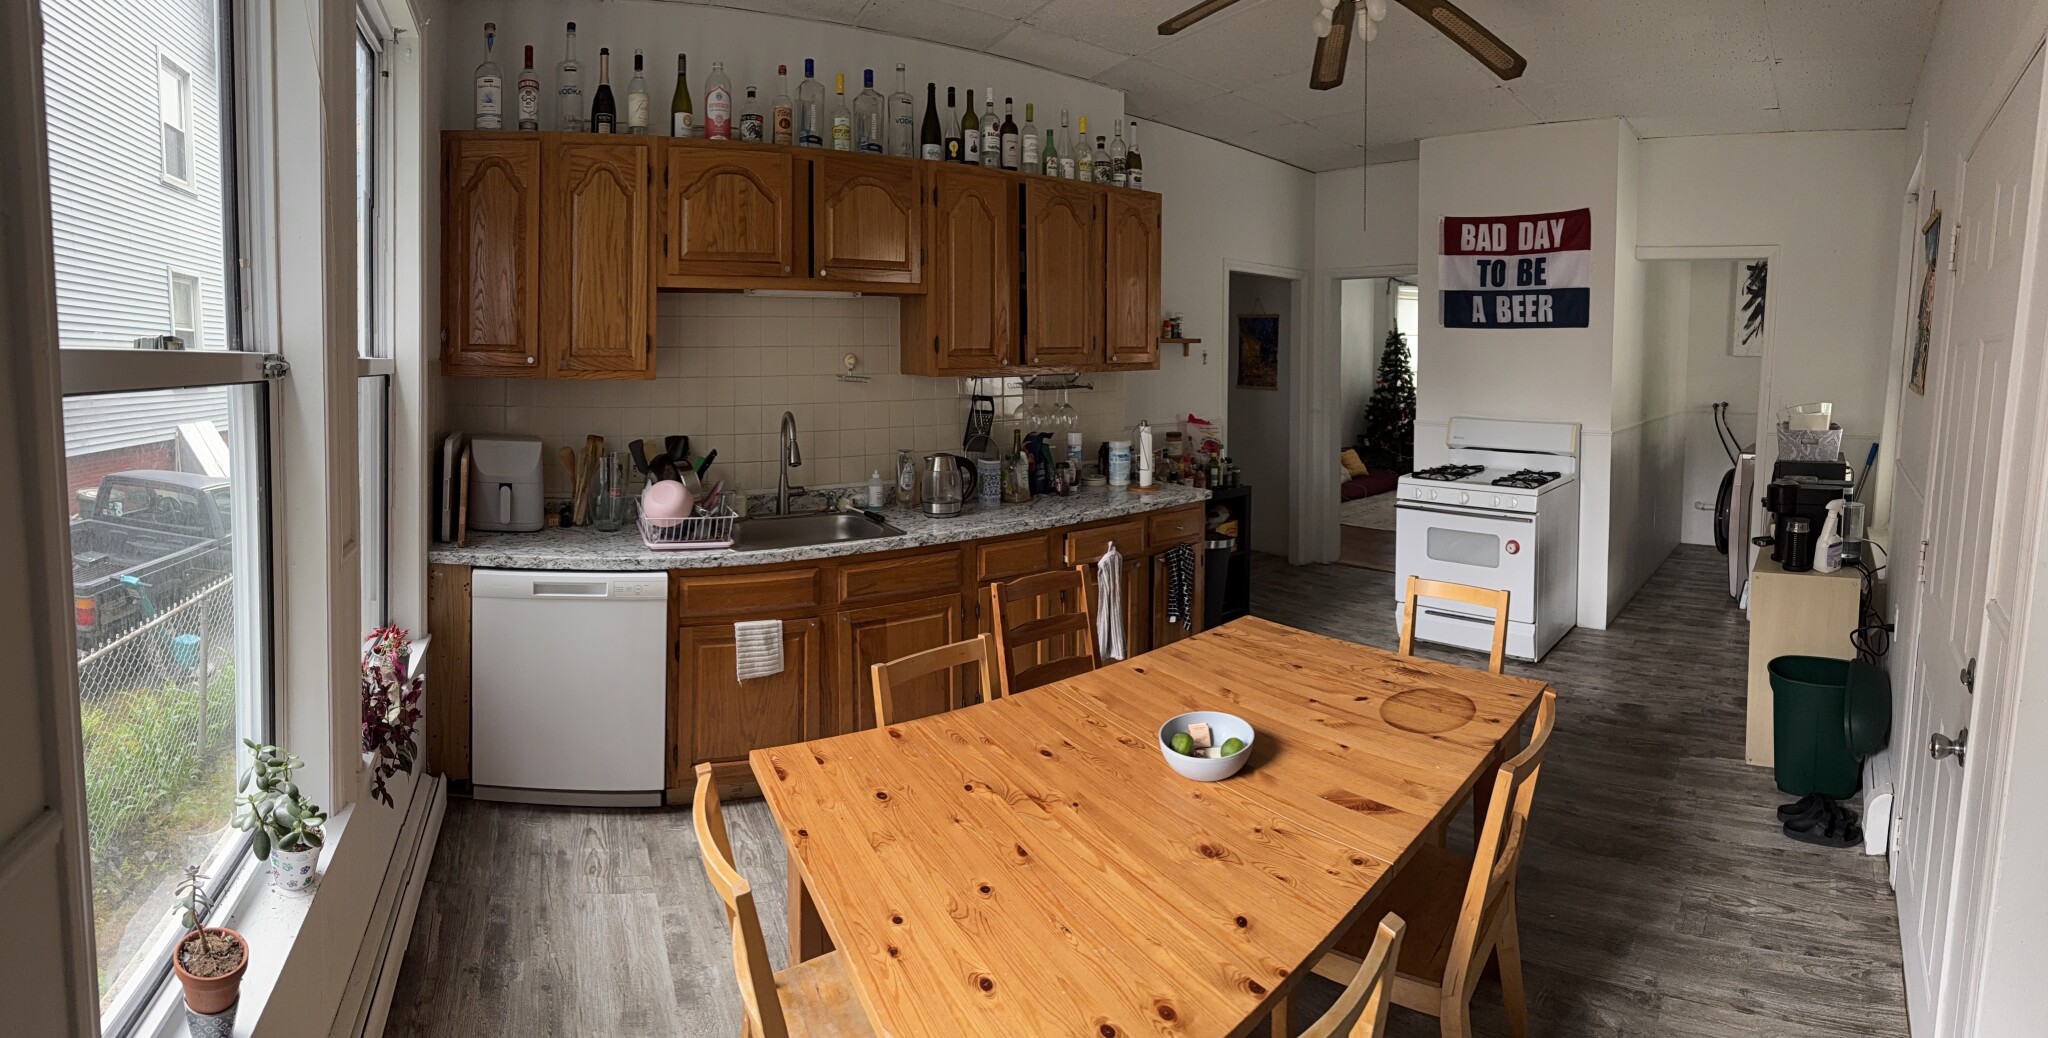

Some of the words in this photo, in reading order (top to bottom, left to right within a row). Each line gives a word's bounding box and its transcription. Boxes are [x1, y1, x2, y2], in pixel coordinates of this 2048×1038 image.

[558, 88, 583, 97] VODKA
[1460, 223, 1507, 252] BAD
[1518, 218, 1566, 251] DAY
[1477, 259, 1507, 288] TO
[1517, 257, 1547, 287] BE
[1472, 295, 1487, 323] A
[1496, 294, 1553, 324] BEER
